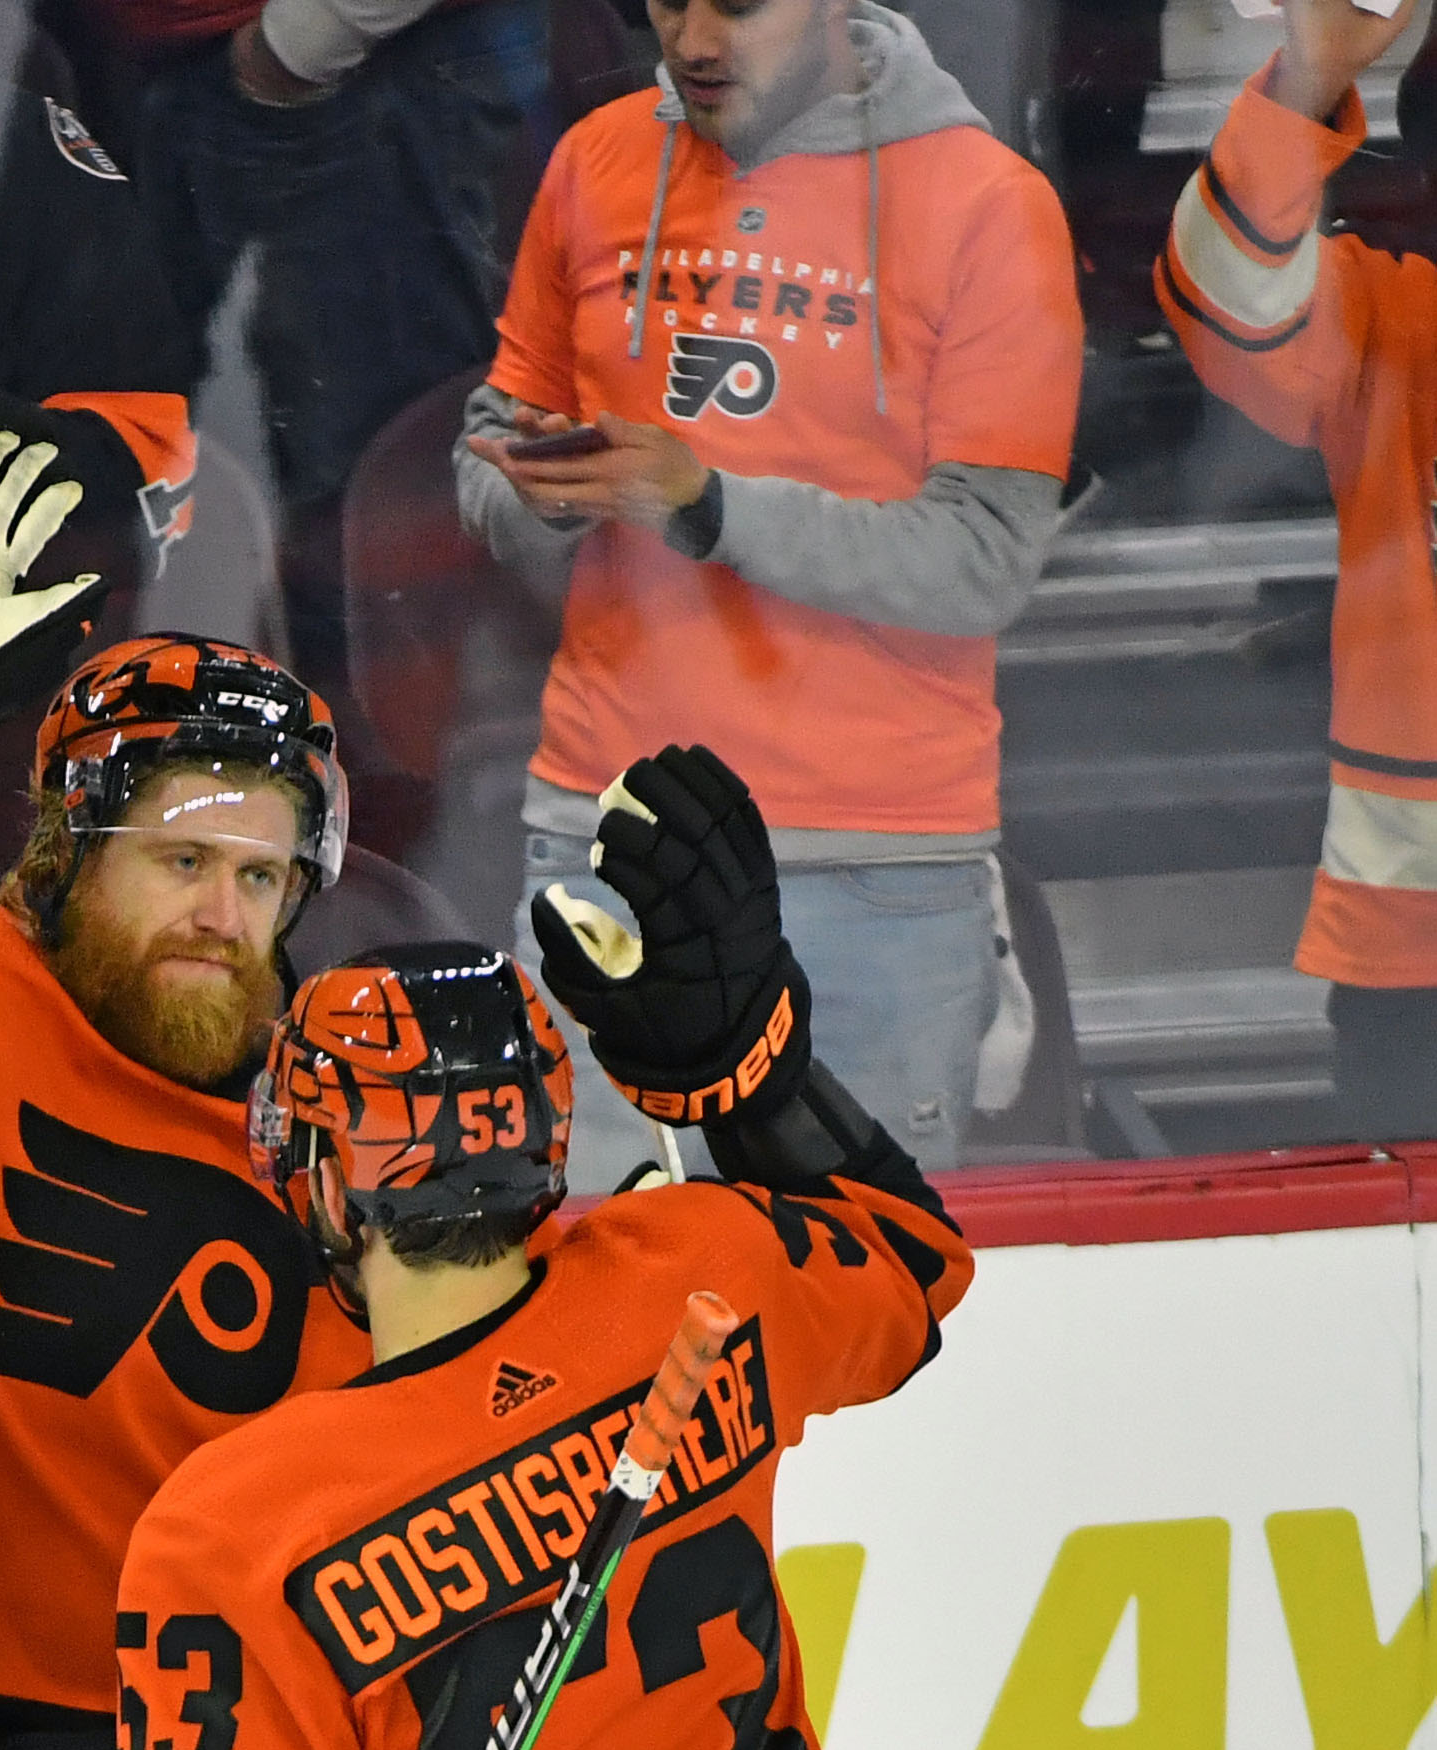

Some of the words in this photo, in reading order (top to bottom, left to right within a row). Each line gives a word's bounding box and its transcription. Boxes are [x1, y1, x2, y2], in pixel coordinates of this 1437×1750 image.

[619, 249, 873, 294] PILADELPHIA
[620, 270, 858, 327] FLYERS
[604, 985, 794, 1123] BAUE
[457, 1083, 527, 1155] 53
[492, 1372, 557, 1417] adidas
